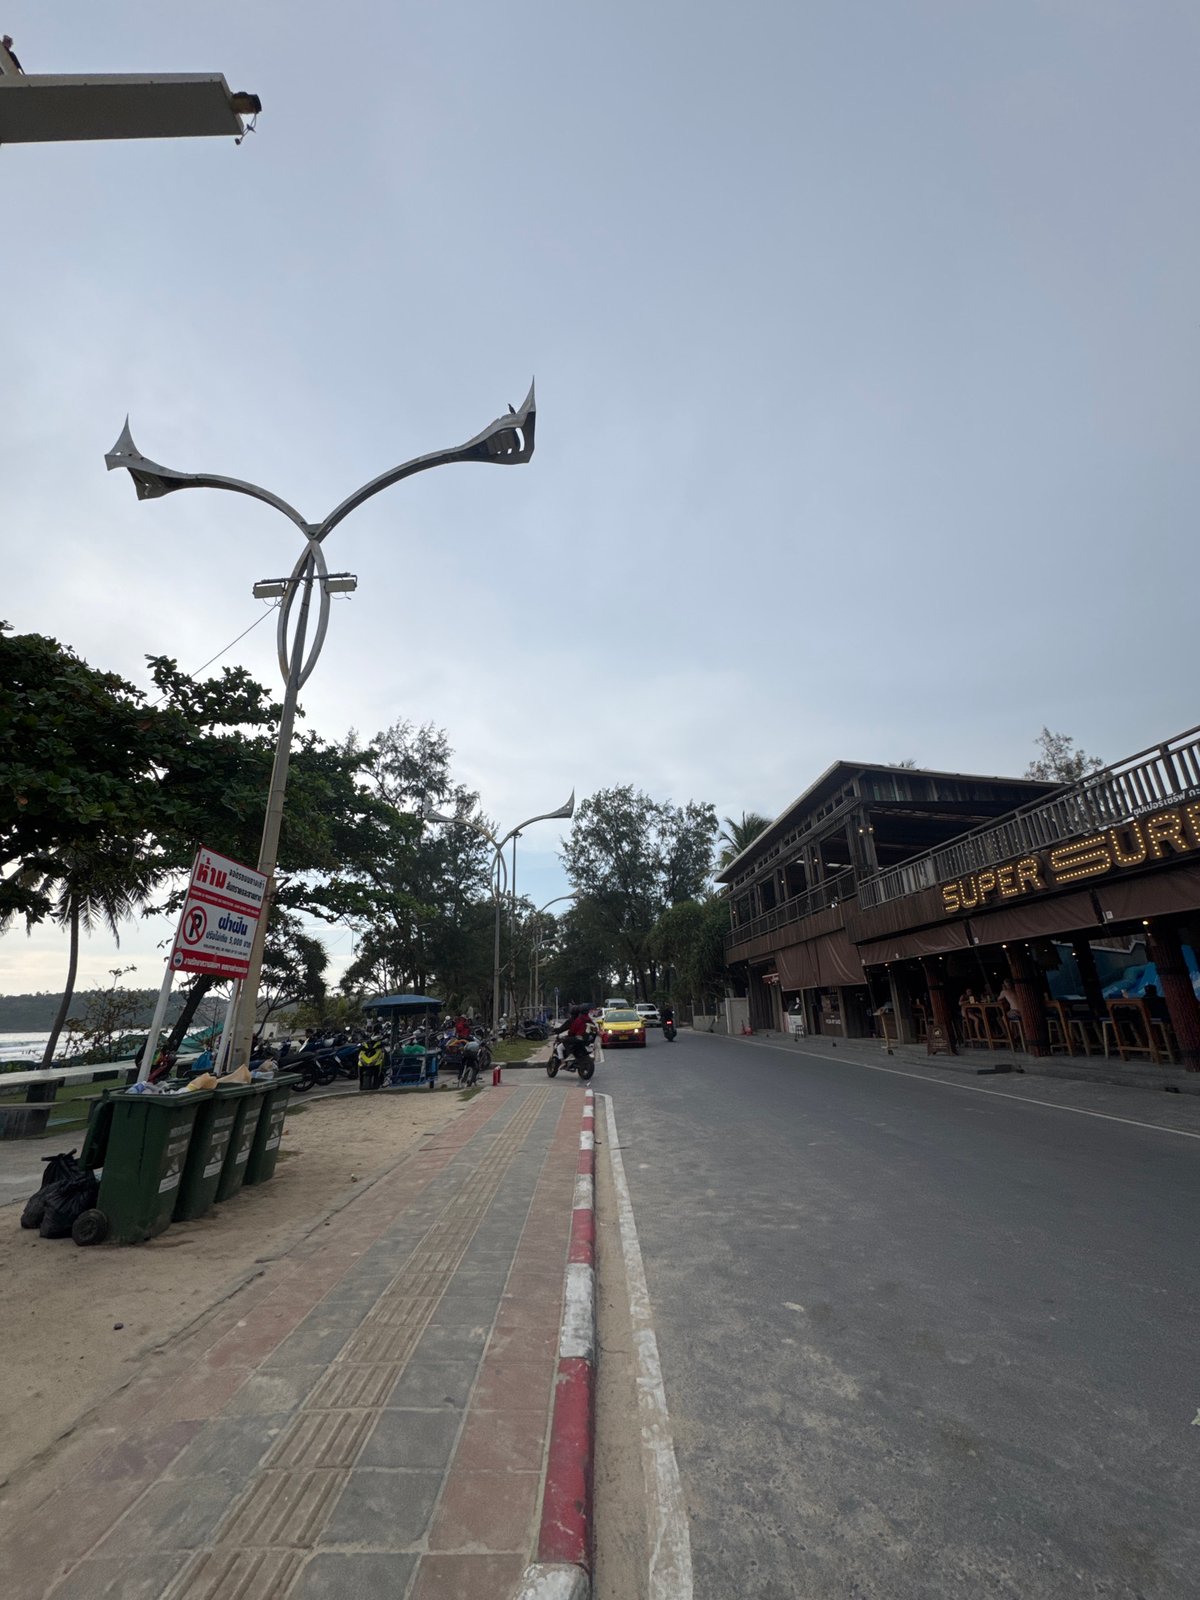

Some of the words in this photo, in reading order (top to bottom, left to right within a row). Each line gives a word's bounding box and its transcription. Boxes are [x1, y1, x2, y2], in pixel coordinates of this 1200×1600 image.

[196, 857, 228, 890] ห้าม
[942, 854, 1048, 914] SUPER
[189, 913, 203, 938] P
[218, 912, 248, 936] ฝ่าฝืน
[228, 937, 243, 947] 5,000
